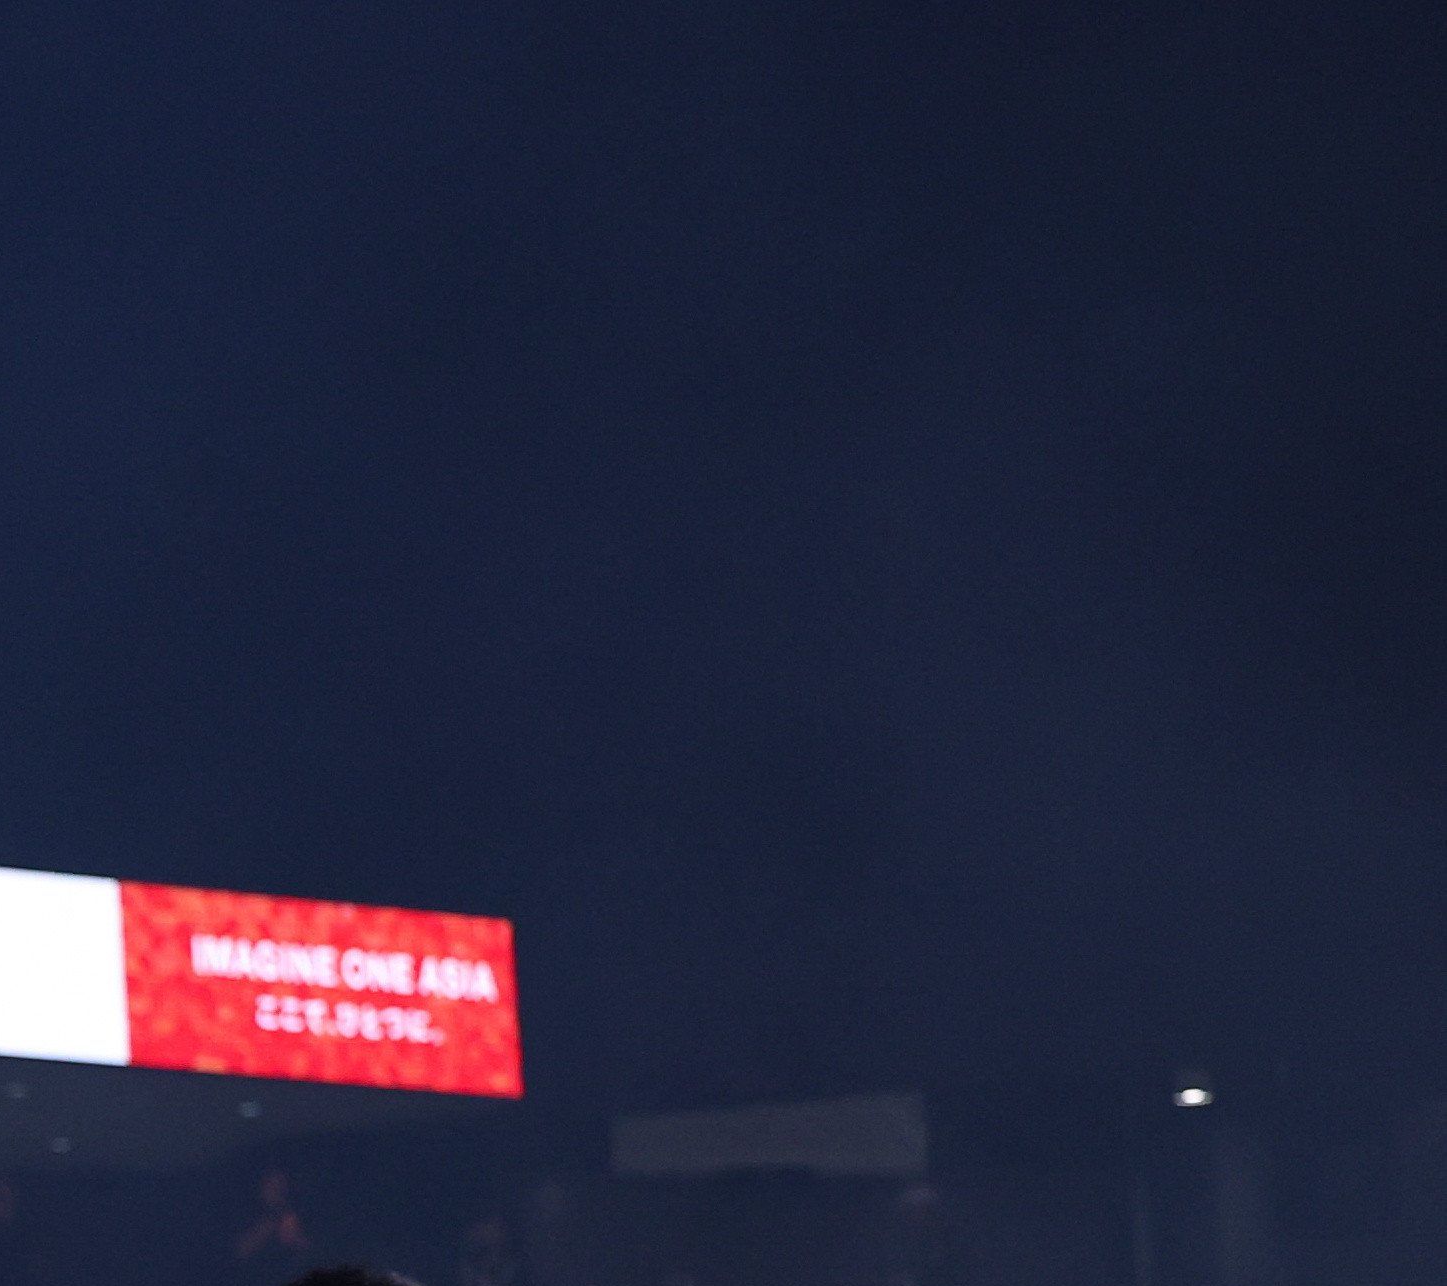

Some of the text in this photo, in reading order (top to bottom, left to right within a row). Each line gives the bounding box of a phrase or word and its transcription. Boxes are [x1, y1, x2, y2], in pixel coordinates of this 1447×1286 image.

[191, 934, 499, 1003] IMAGINE ONE ASIA
